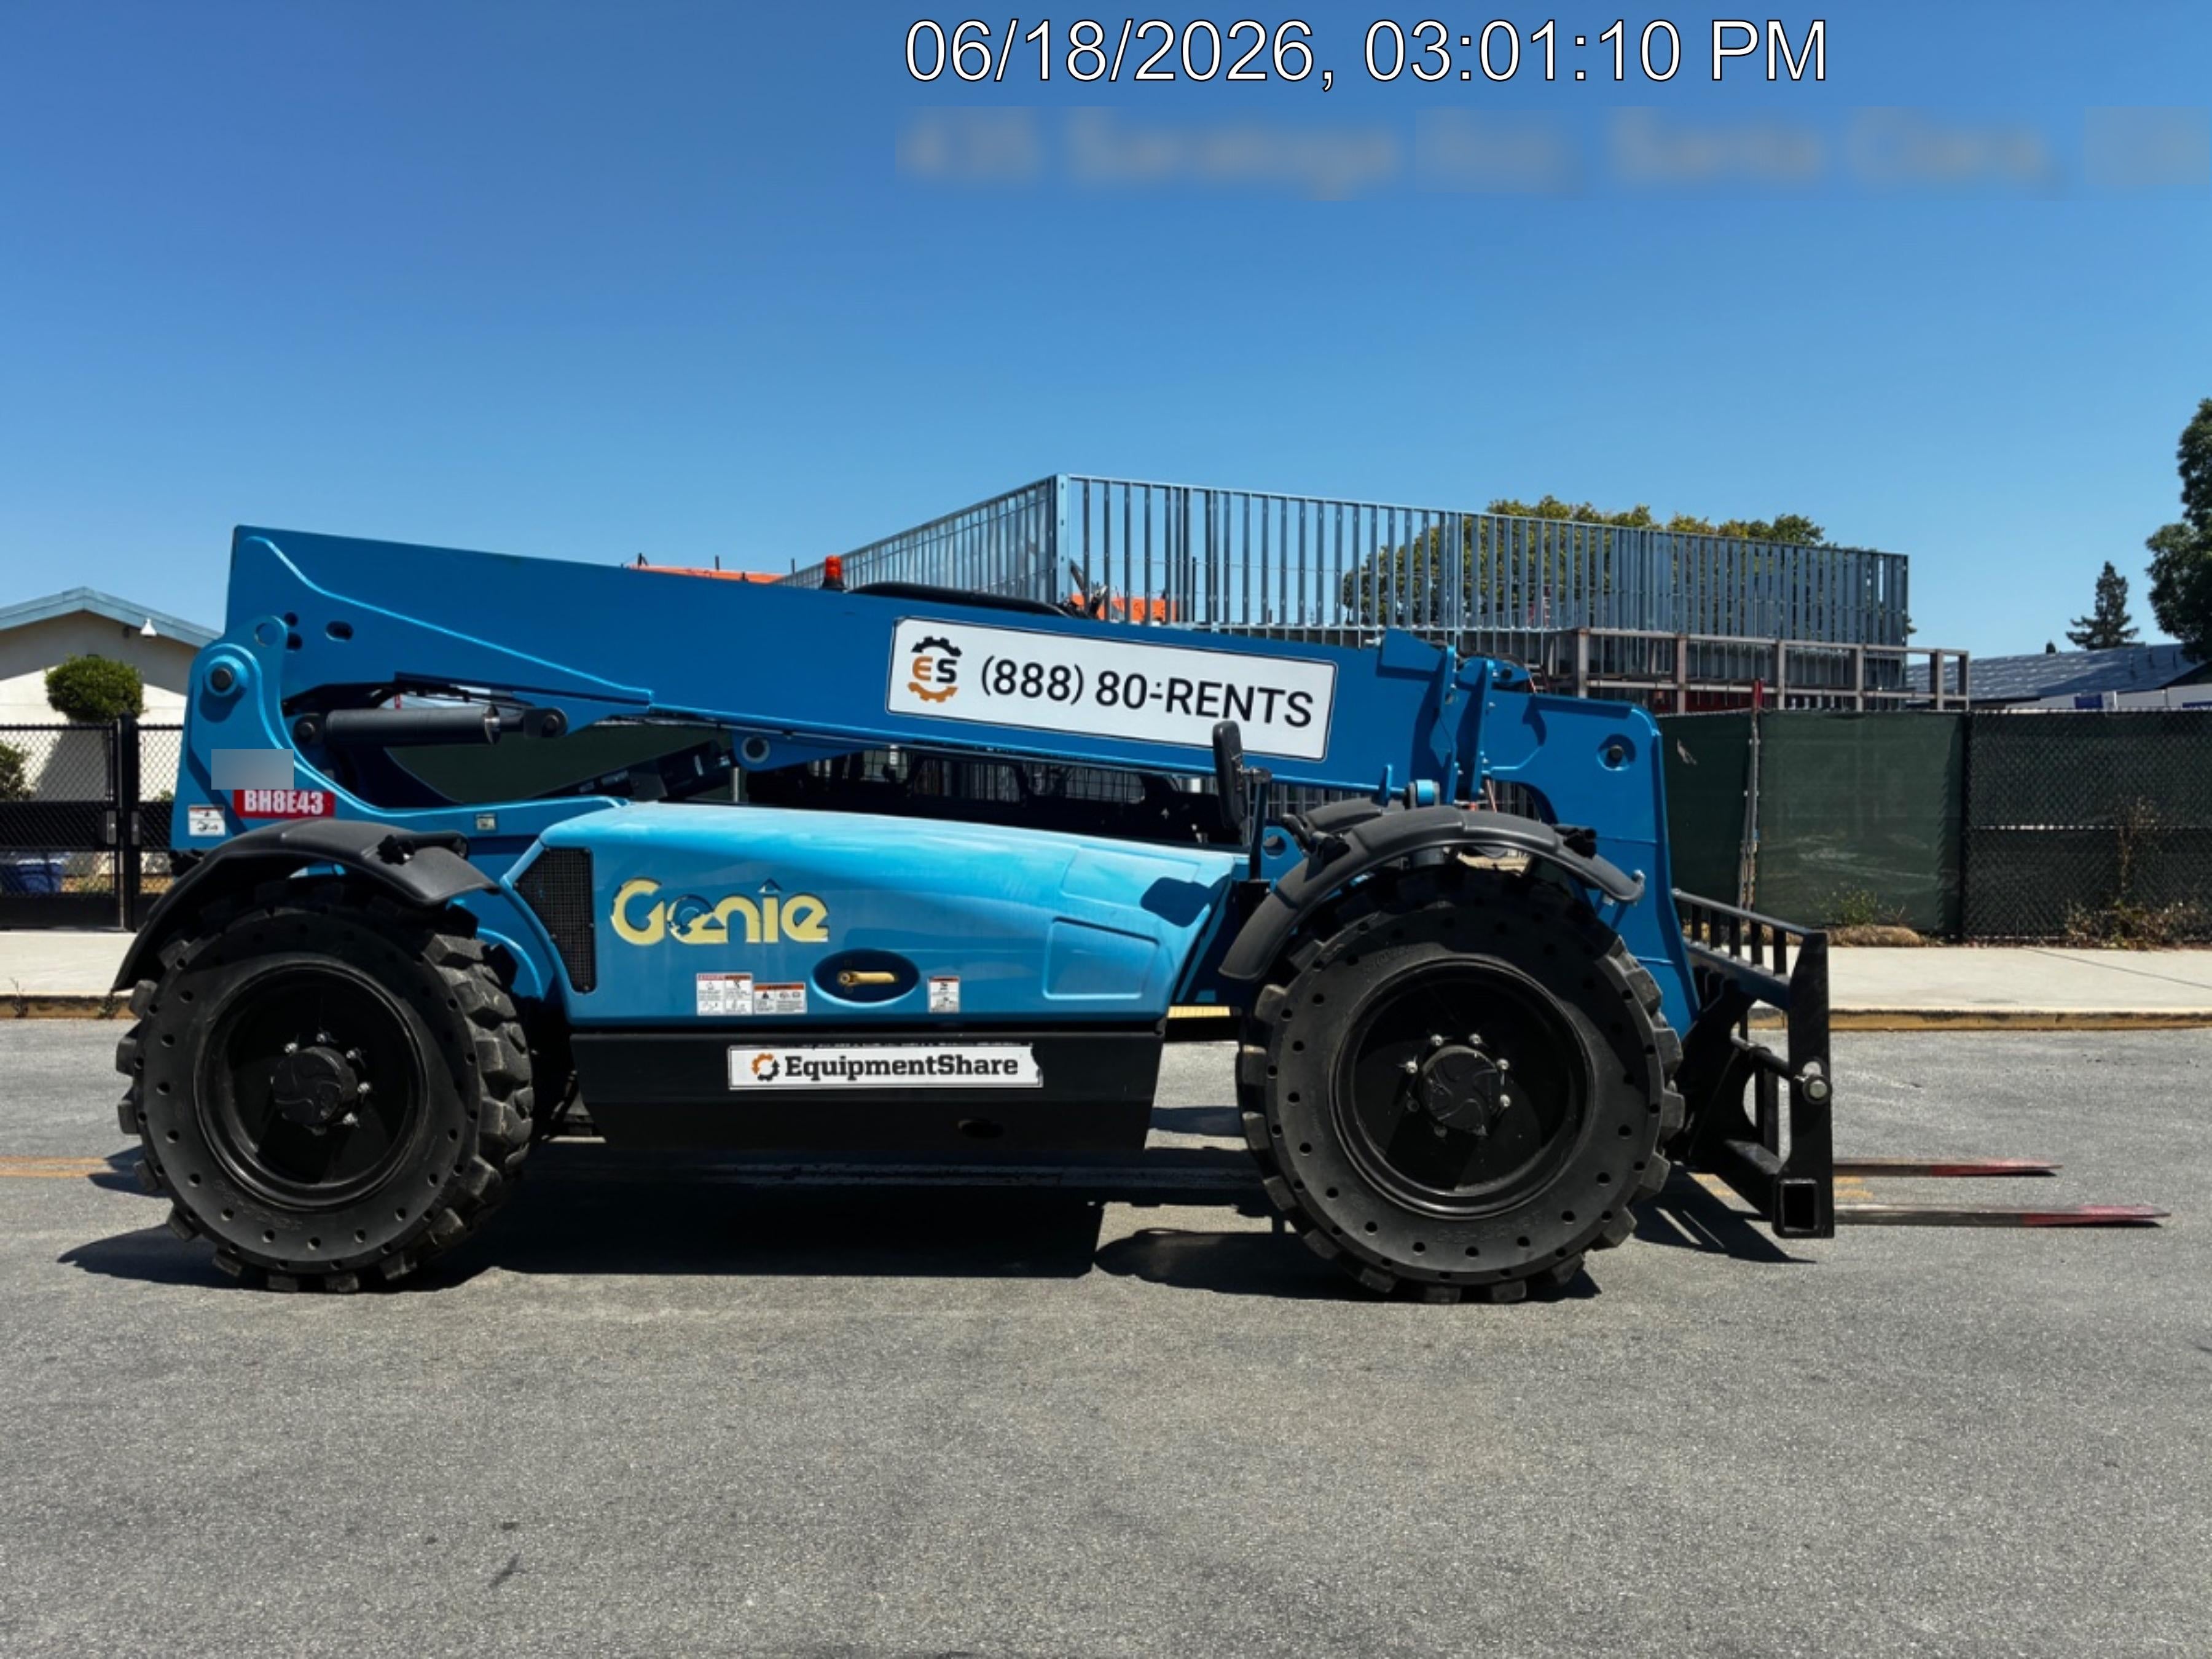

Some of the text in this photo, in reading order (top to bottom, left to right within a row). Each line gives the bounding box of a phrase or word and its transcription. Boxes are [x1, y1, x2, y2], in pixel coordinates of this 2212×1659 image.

[912, 655, 957, 684] ES
[981, 655, 1084, 705] (888)
[245, 790, 324, 815] BH8E43
[611, 877, 830, 945] Genie
[785, 1054, 1019, 1081] EquipmentShare
